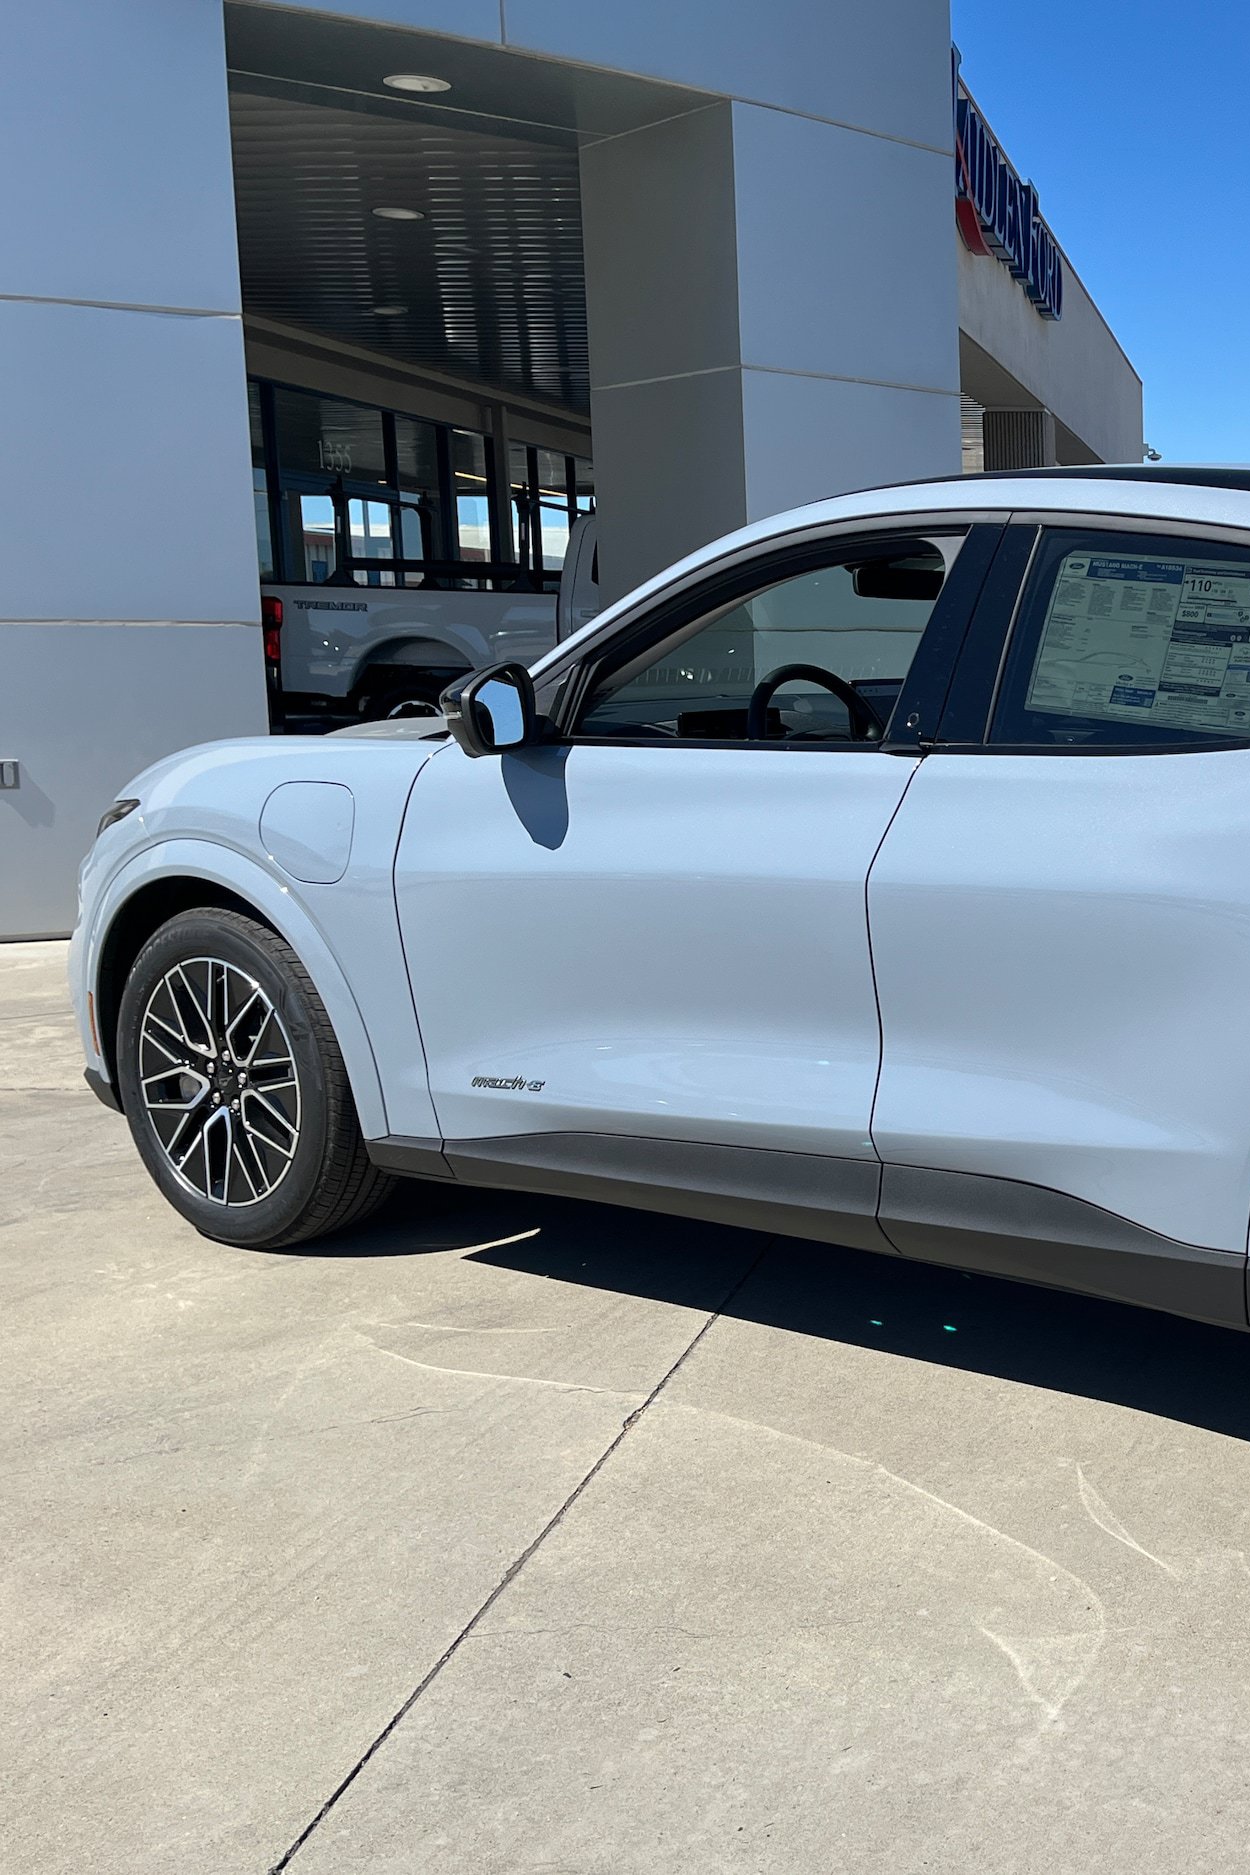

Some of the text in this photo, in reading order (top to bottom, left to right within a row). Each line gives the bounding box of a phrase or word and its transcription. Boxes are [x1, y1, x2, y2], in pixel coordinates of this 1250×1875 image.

[951, 42, 1026, 273] AIDLEN
[1190, 579, 1212, 592] 110
[293, 600, 368, 612] TREMOR
[1182, 610, 1199, 618] $800
